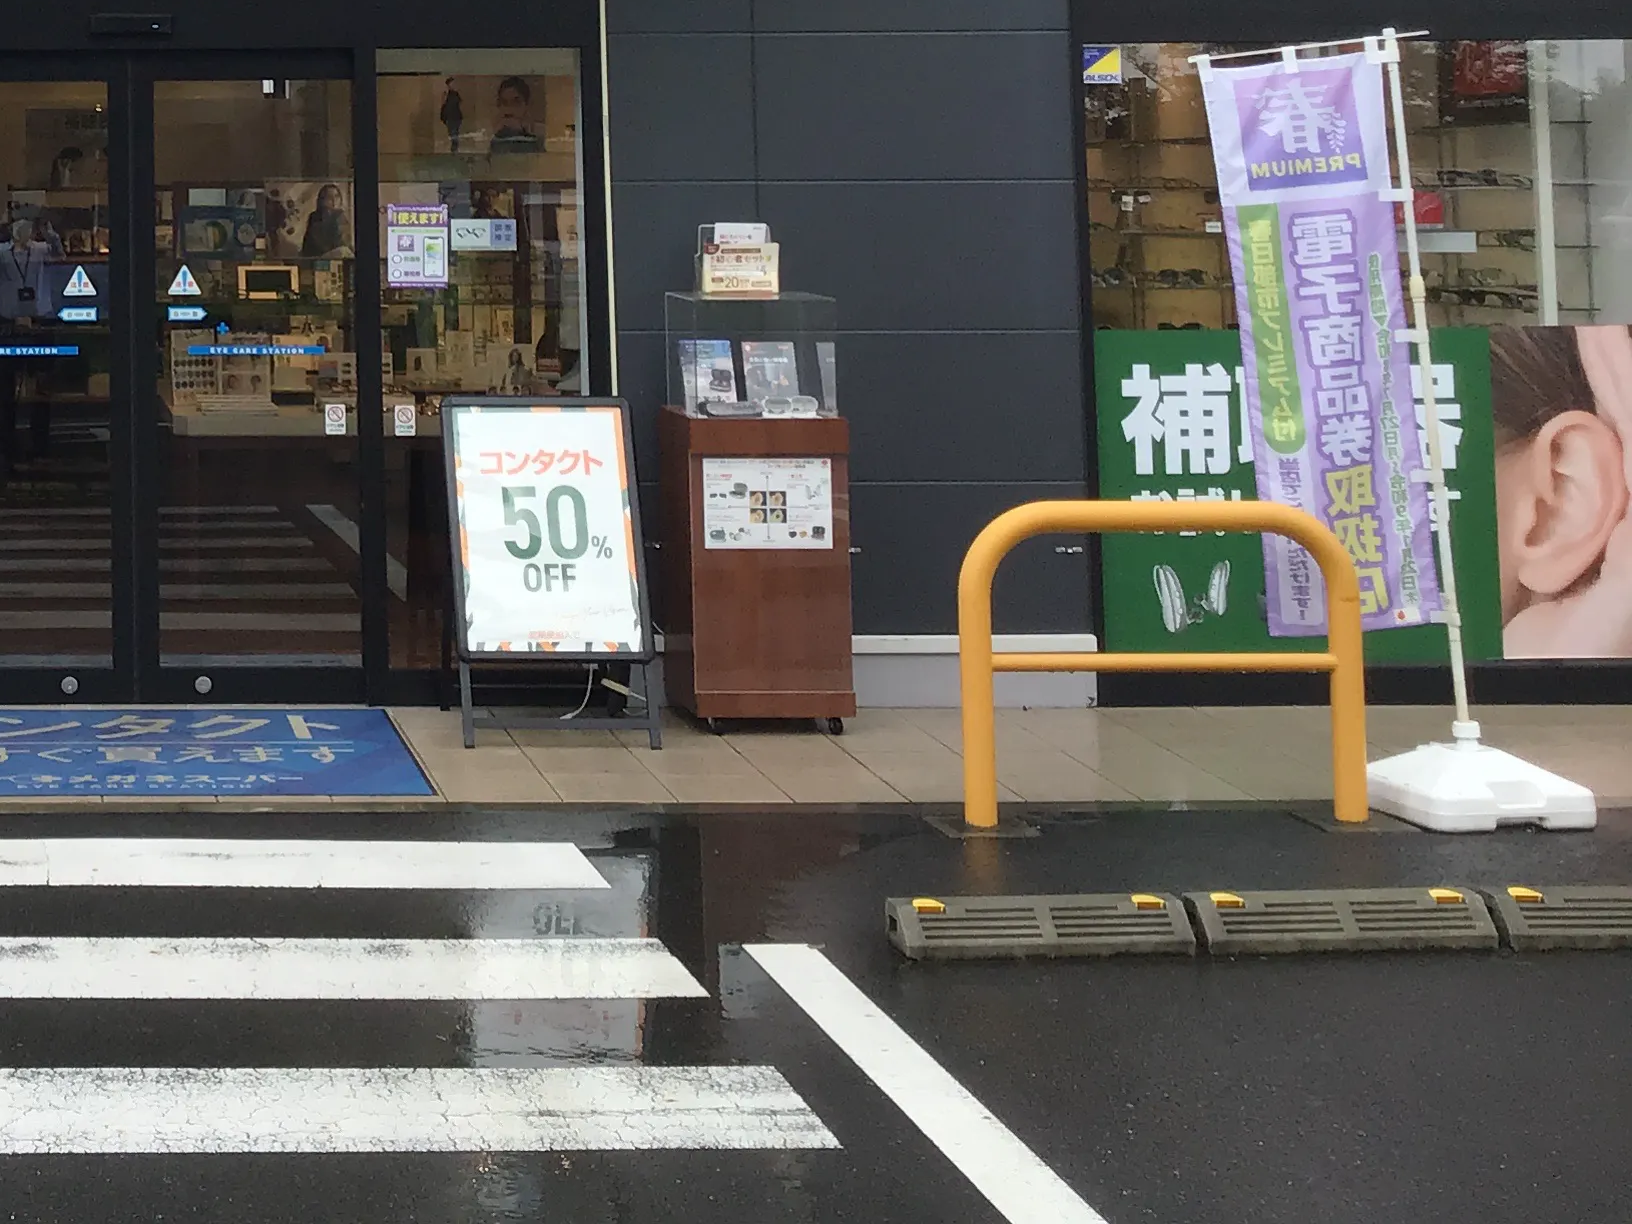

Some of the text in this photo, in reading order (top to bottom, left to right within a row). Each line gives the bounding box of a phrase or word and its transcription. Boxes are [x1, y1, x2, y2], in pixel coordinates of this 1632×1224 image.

[15, 347, 59, 355] STATION
[479, 449, 604, 476] コンタクト
[523, 562, 577, 593] OFF
